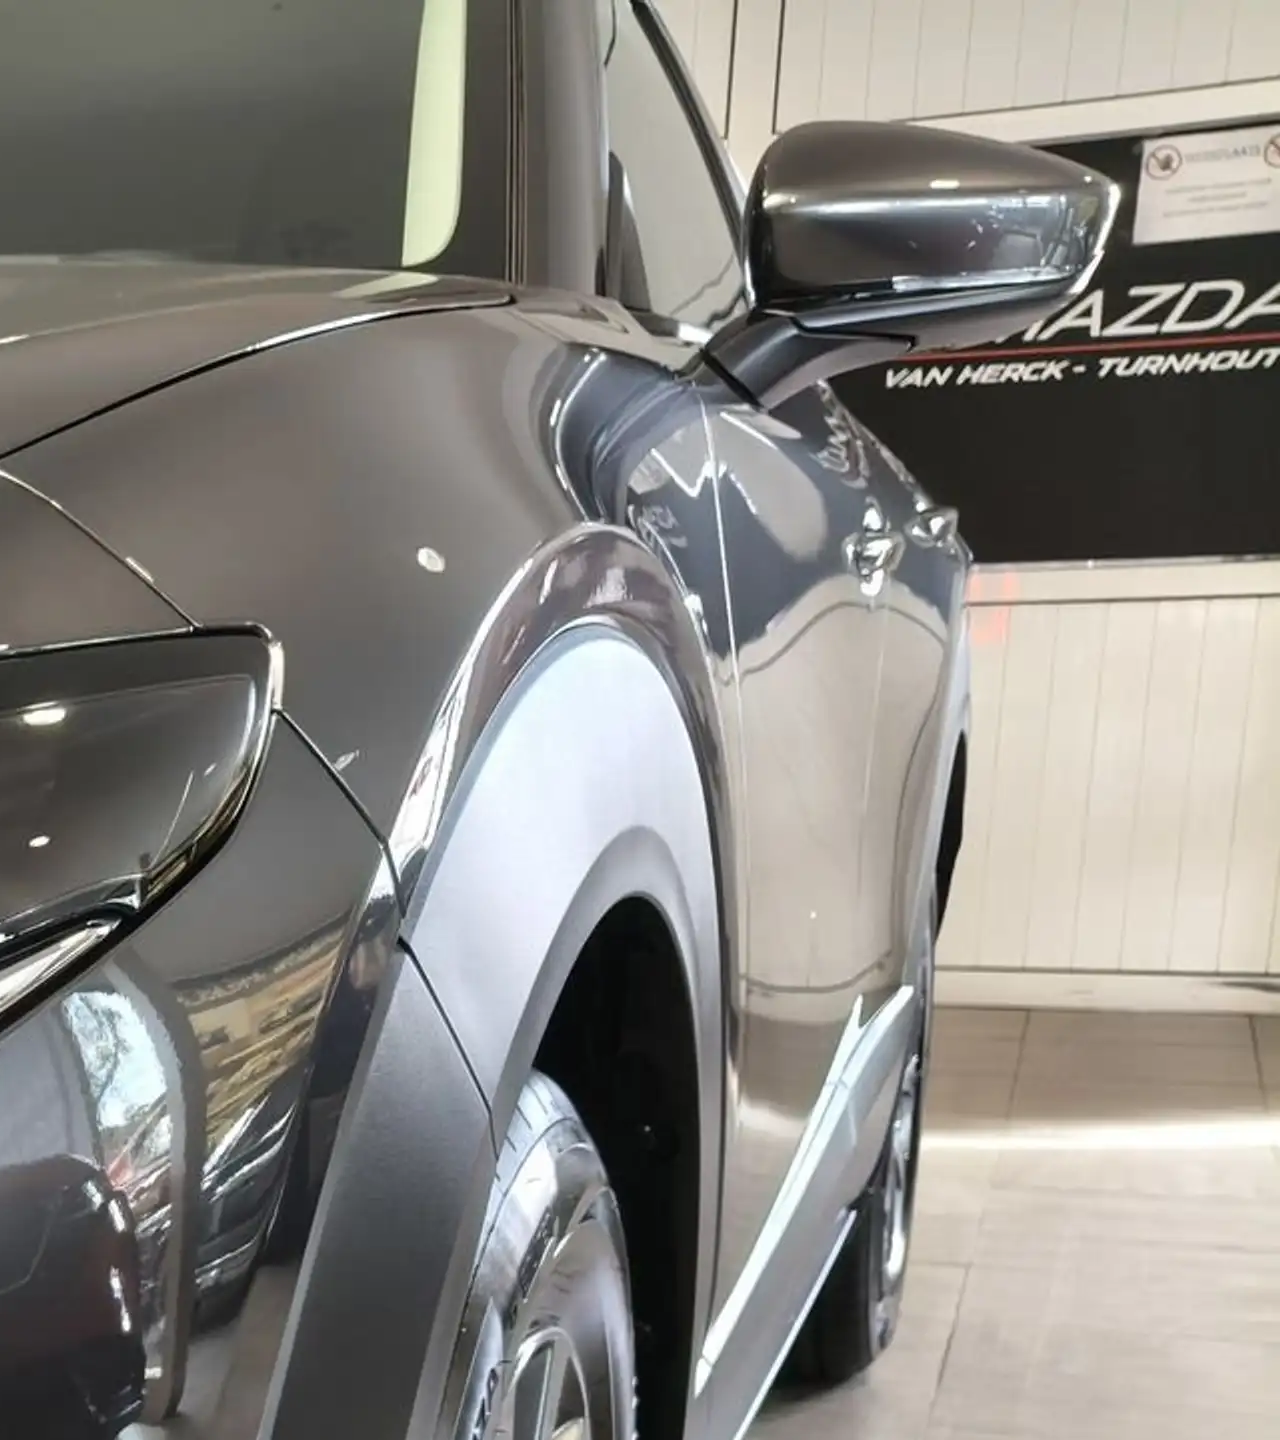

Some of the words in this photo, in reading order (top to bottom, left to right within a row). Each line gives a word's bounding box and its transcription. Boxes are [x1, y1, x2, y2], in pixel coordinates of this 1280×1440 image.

[996, 280, 1280, 343] AZDA
[885, 366, 949, 389] VAN
[956, 359, 1071, 386] HERCK
[1098, 347, 1280, 379] TURNHOUT
